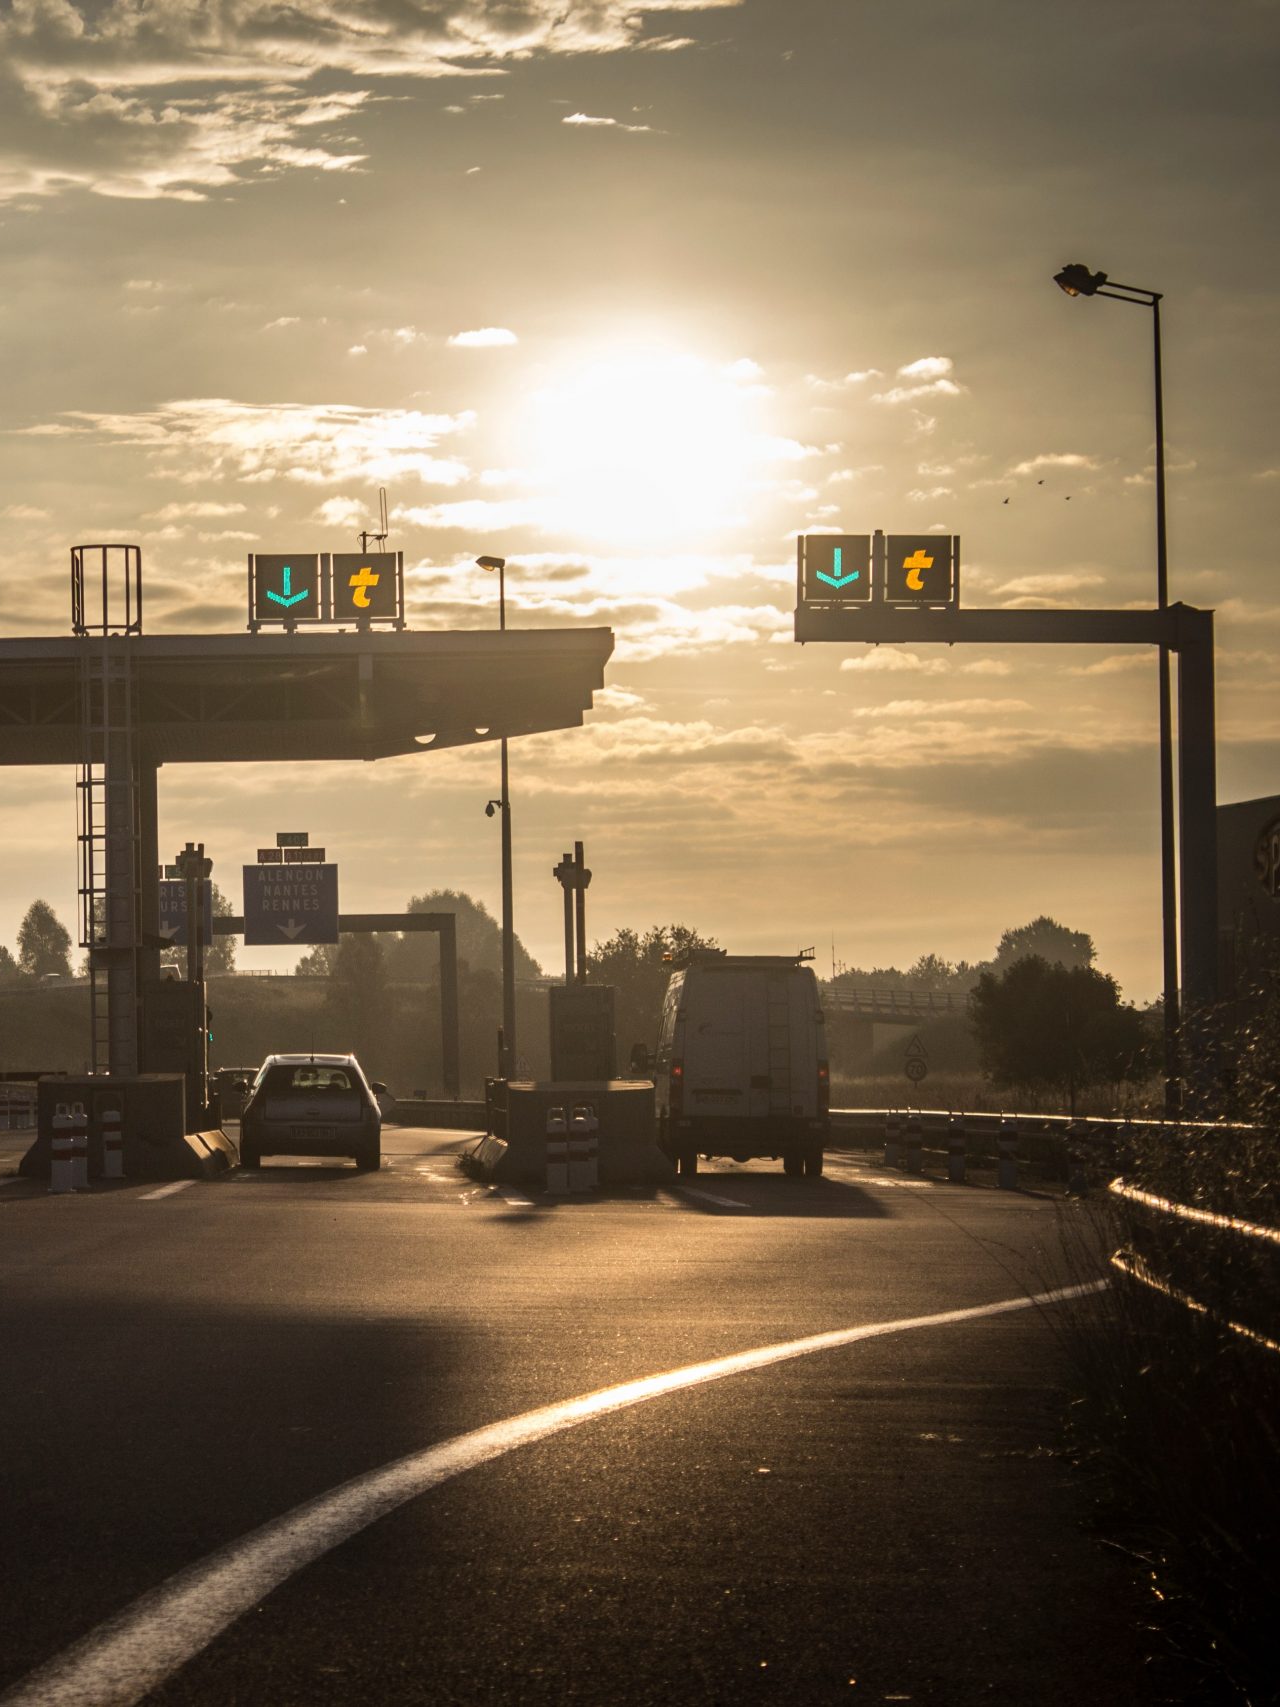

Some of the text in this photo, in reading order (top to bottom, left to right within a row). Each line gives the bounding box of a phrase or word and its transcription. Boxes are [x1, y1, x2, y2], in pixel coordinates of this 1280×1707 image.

[160, 885, 185, 898] RIS
[263, 884, 318, 897] NANTES
[160, 900, 188, 913] URS
[262, 898, 320, 911] RENNES
